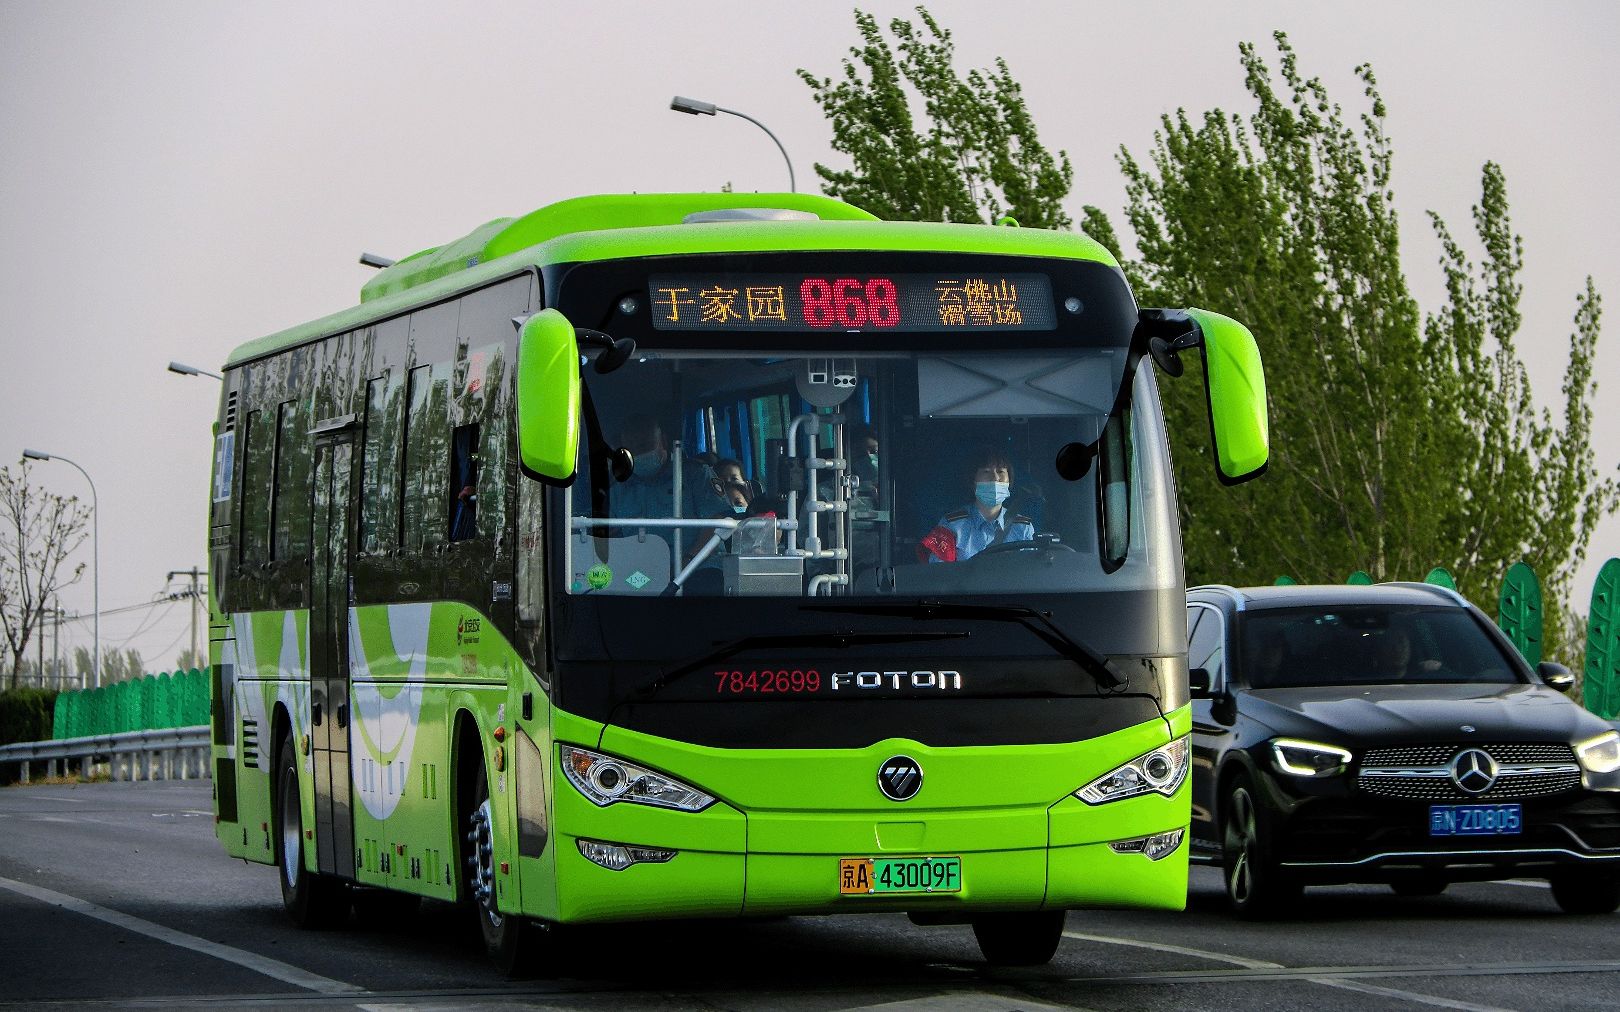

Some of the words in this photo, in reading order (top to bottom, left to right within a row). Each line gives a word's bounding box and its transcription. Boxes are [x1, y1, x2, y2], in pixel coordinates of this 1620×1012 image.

[655, 285, 787, 323] 于家园
[800, 278, 901, 328] 868
[935, 278, 1018, 304] 云佛山
[938, 303, 1023, 326] 滑雪场
[715, 671, 820, 693] 7842699
[831, 670, 962, 690] FOTON
[879, 862, 958, 888] 43009F
